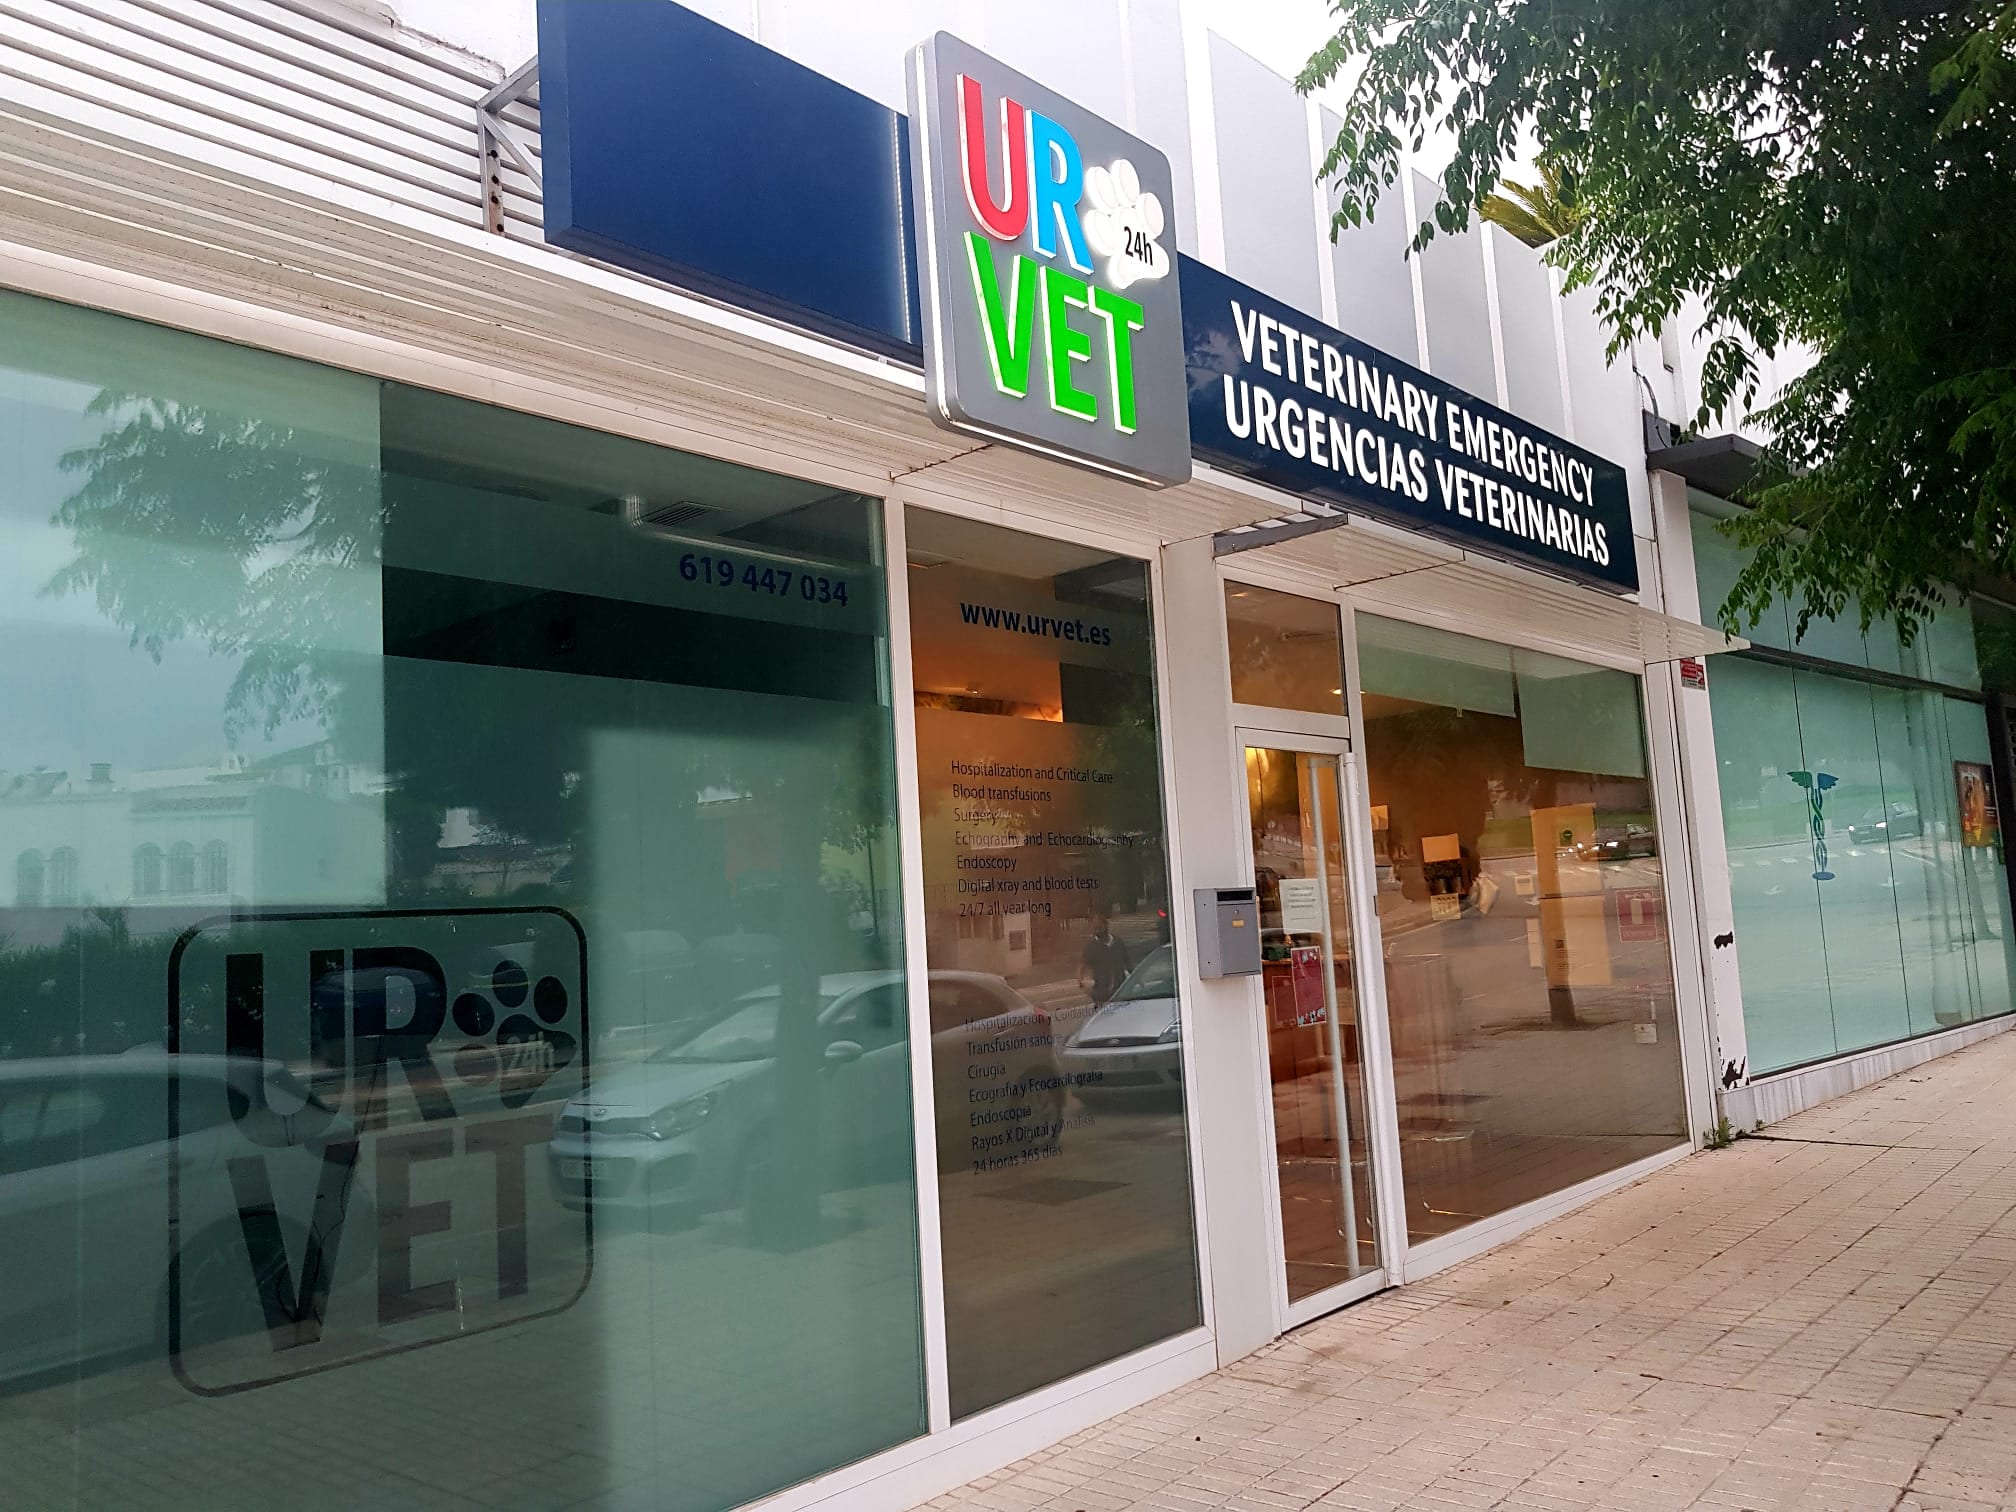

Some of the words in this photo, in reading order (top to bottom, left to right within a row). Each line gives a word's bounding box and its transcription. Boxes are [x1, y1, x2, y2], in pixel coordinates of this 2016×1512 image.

[957, 73, 1093, 276] UR
[1123, 225, 1154, 267] 24h
[963, 230, 1144, 436] VET
[1229, 299, 1438, 442] VETERINARY
[1447, 402, 1594, 507] EMERGENCY
[1223, 374, 1428, 503] URGENCIAS
[1434, 457, 1610, 568] VETERINARIAS
[679, 553, 734, 588] 619
[742, 561, 794, 597] 447
[800, 574, 849, 607] 034
[960, 601, 1112, 648] www.urvet.es
[951, 760, 1032, 779] Hospitalization
[1035, 767, 1054, 780] and
[1056, 767, 1089, 783] Critical
[1092, 769, 1113, 784] Care
[952, 783, 985, 799] Blood
[988, 785, 1051, 802] transfusions
[954, 807, 997, 826] Surgery
[955, 830, 1020, 849] Echography
[1024, 832, 1042, 846] and
[957, 854, 1017, 872] Endoscopy
[958, 878, 995, 896] Digital
[997, 880, 1020, 896] xray
[1022, 877, 1042, 892] and
[1044, 875, 1073, 891] blood
[1076, 877, 1099, 890] tests
[960, 902, 984, 917] 24/7
[988, 900, 1000, 916] all
[1003, 902, 1026, 917] year
[1028, 898, 1052, 917] long
[226, 946, 457, 1148] UR
[971, 1132, 1003, 1152] Rayos
[1006, 1129, 1013, 1143] X
[1016, 1121, 1049, 1144] Digital
[973, 1159, 986, 1175] 24
[989, 1154, 1019, 1172] horas
[1021, 1147, 1040, 1164] 365
[226, 1113, 555, 1353] VET
